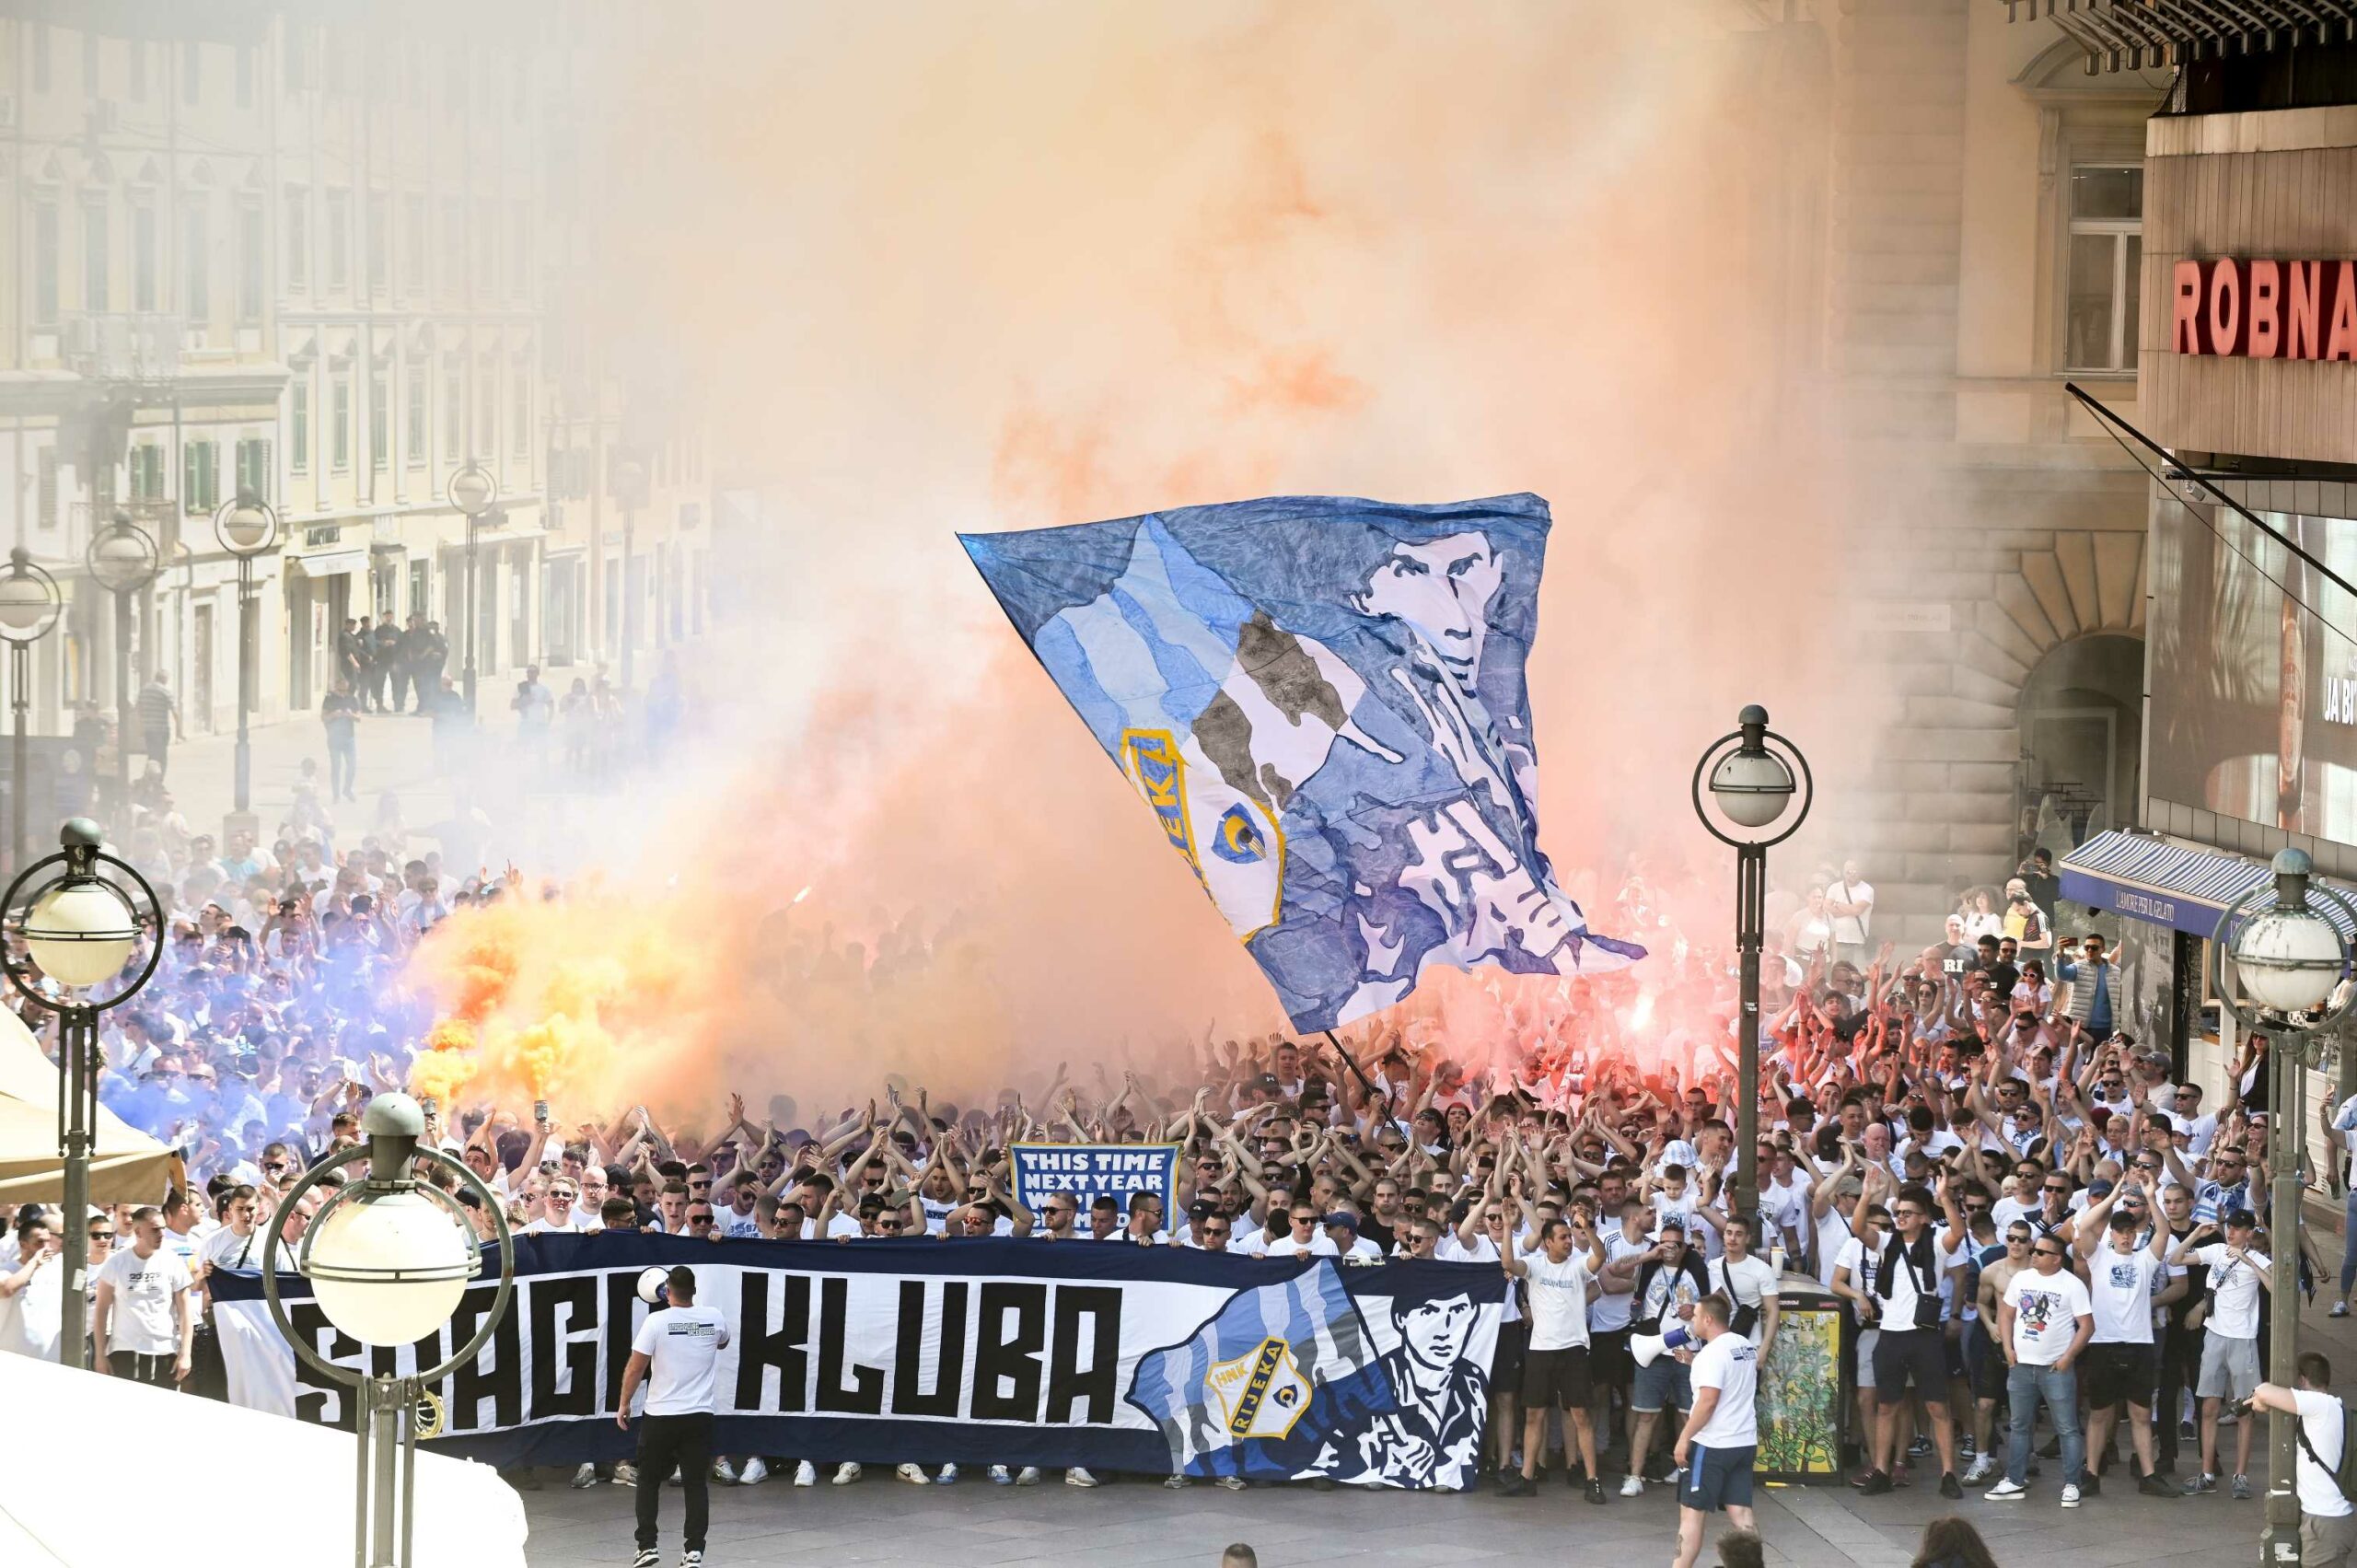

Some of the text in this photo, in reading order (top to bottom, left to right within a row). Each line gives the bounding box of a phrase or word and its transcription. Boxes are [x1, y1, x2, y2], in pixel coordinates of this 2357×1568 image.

[2172, 256, 2357, 362] ROBNA
[2325, 677, 2340, 722] JA
[2154, 900, 2175, 922] GELATO
[1943, 958, 1964, 972] RI
[1021, 1154, 1166, 1171] THIS TIME
[1025, 1174, 1163, 1191] NEXT YEAR
[734, 1272, 1122, 1424] KLUBA
[1215, 1363, 1248, 1387] HNK
[1234, 1346, 1281, 1429] RIJEKA
